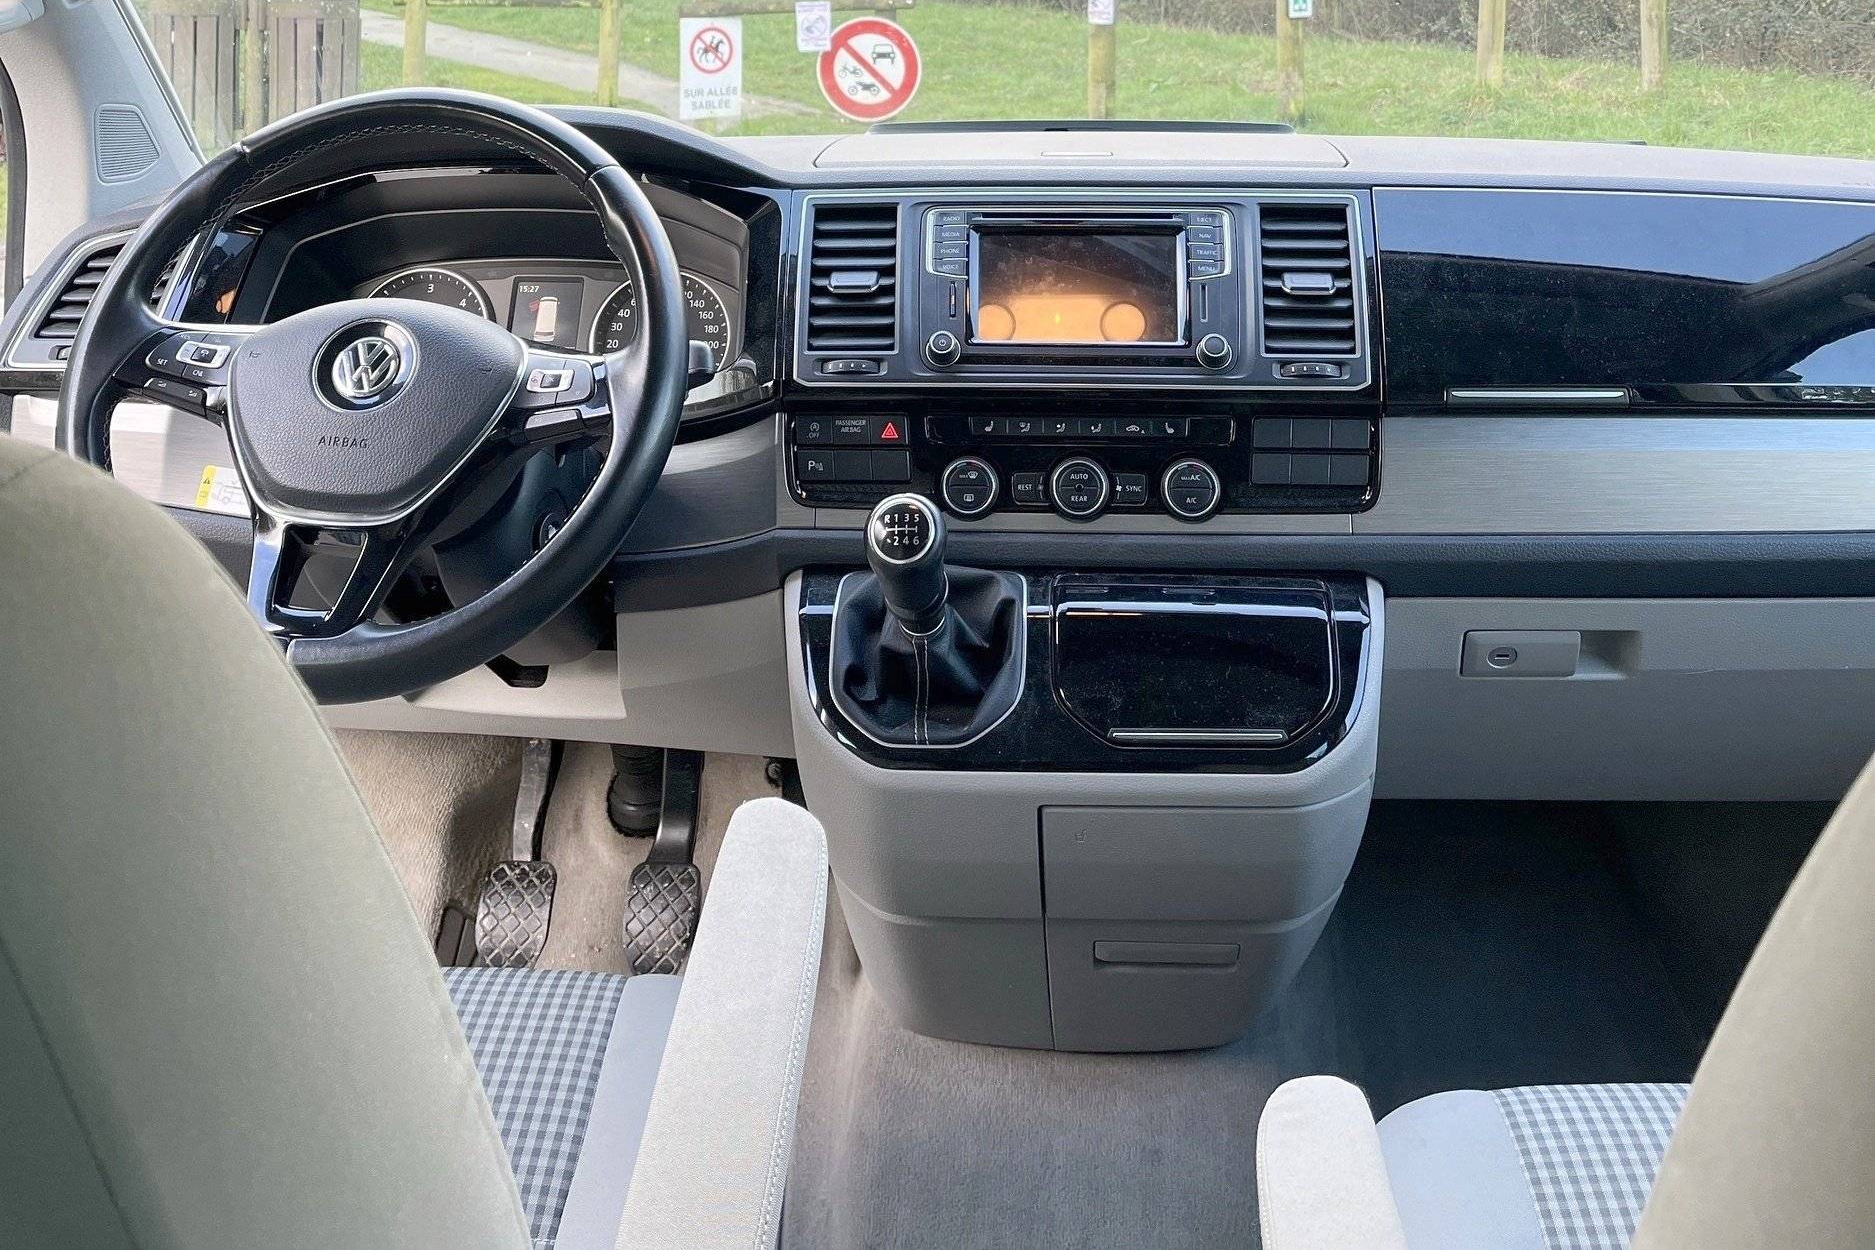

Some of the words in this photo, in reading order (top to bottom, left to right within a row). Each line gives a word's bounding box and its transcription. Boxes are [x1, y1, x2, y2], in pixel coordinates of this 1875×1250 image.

[684, 88, 705, 98] SUR
[427, 283, 435, 294] 3
[519, 284, 540, 294] 15:27
[459, 298, 467, 308] 4
[689, 299, 705, 309] 140
[617, 308, 631, 319] 40
[698, 311, 714, 321] 160
[610, 322, 623, 332] 30
[704, 324, 719, 334] 180
[606, 339, 619, 349] 20
[156, 358, 168, 366] SET
[317, 436, 368, 449] AIRBAG
[1017, 483, 1033, 491] REST
[1185, 496, 1197, 504] A/C
[884, 514, 891, 524] R
[893, 513, 899, 523] 1
[904, 513, 910, 522] 3
[913, 513, 920, 523] 5
[893, 536, 900, 546] 2
[902, 535, 910, 545] 4
[912, 535, 920, 546] 6
